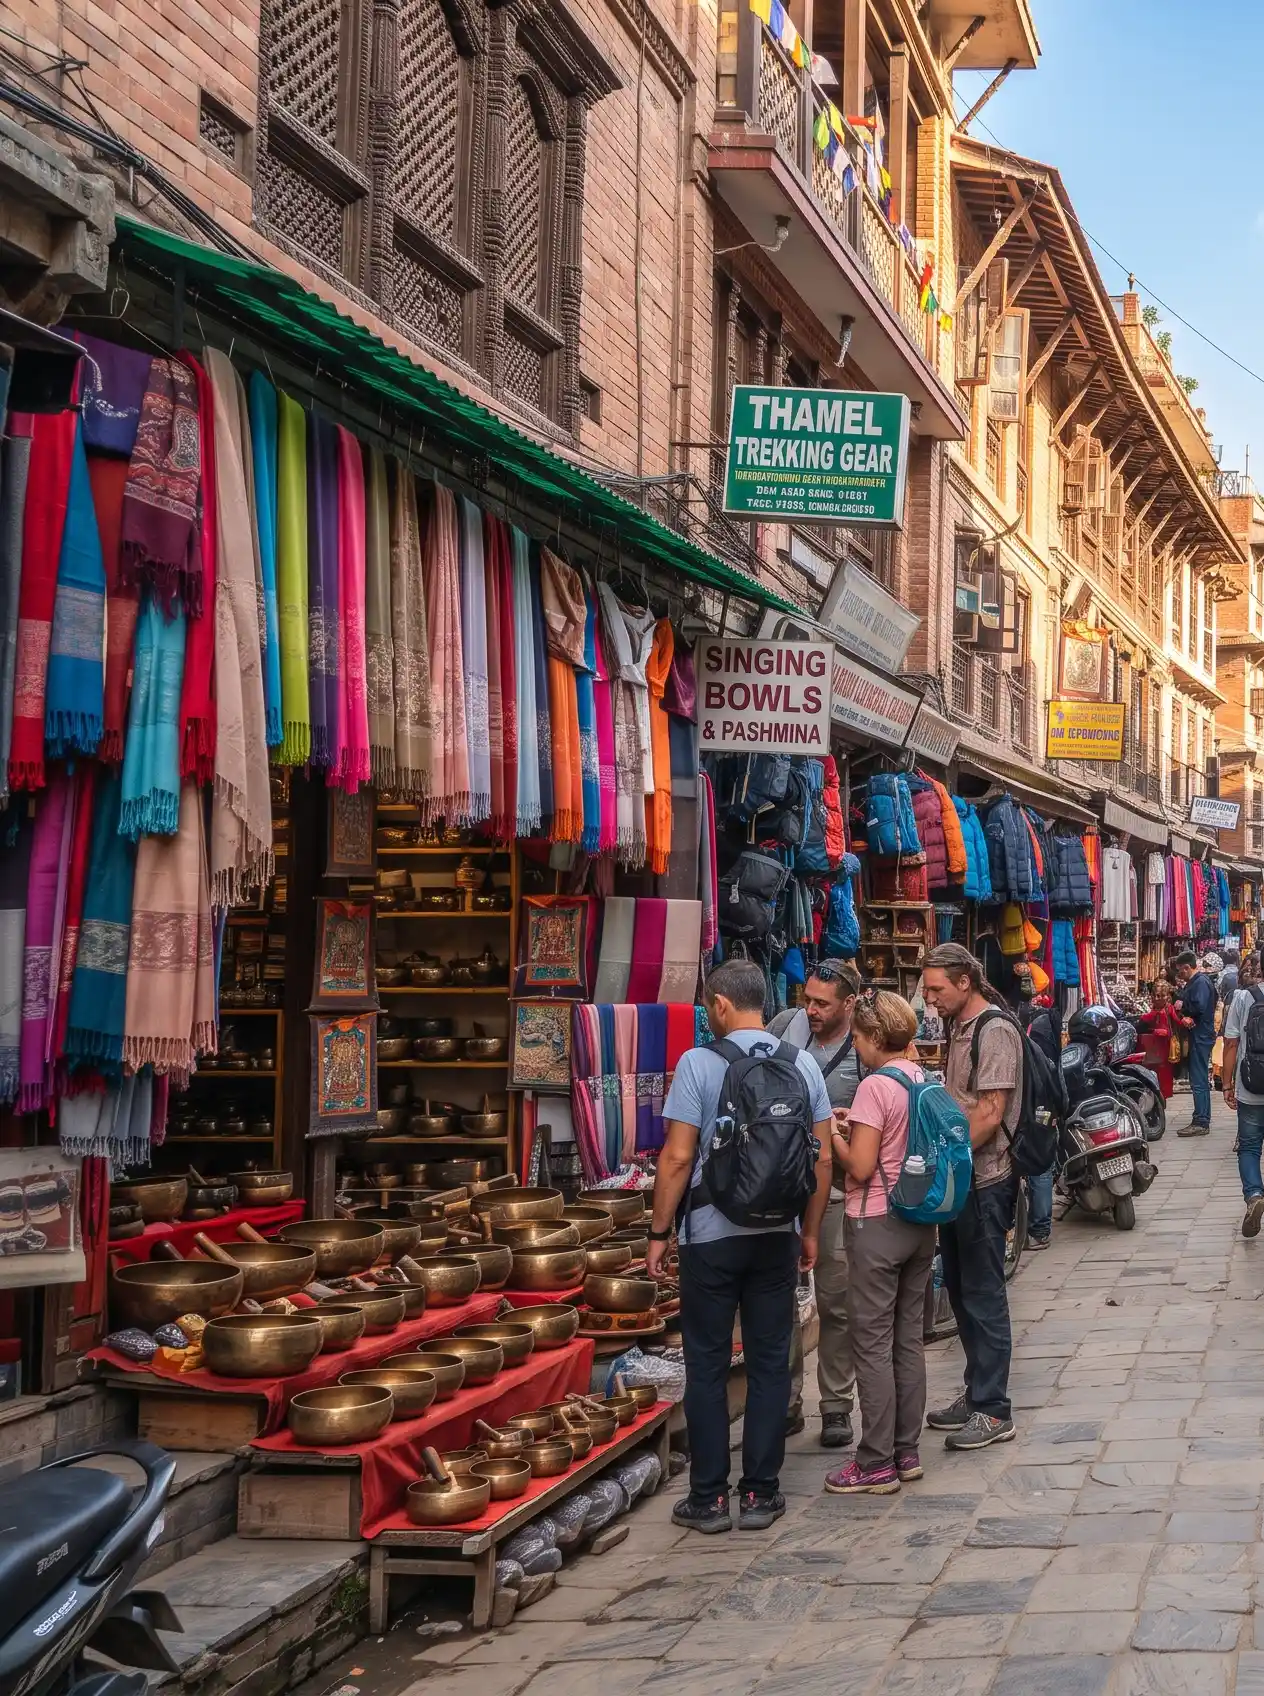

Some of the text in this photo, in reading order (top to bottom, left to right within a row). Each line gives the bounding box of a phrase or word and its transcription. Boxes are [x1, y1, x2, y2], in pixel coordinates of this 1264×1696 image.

[748, 395, 882, 436] THAMEL
[735, 436, 893, 474] TREKKING GEAR
[704, 645, 826, 677] SINGING
[704, 681, 822, 714] BOWLS
[702, 719, 716, 740] &
[721, 720, 822, 745] PASHMINA
